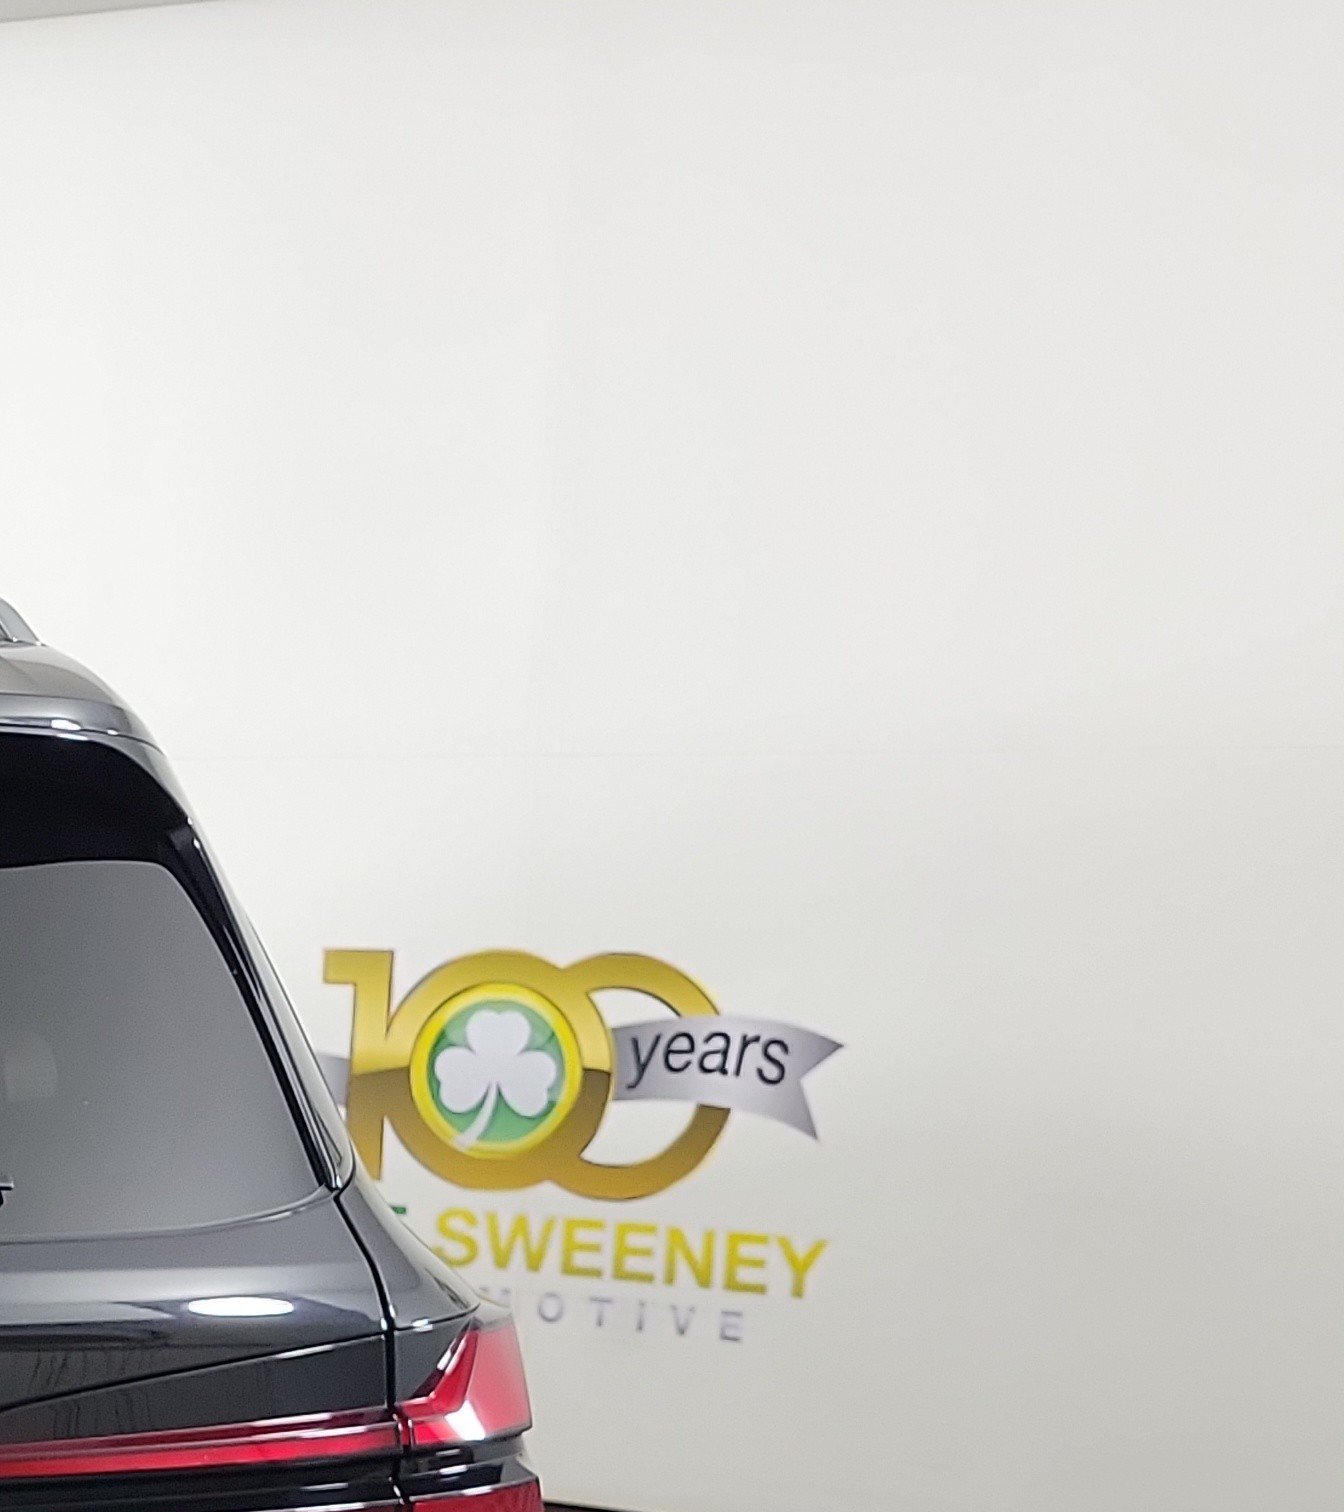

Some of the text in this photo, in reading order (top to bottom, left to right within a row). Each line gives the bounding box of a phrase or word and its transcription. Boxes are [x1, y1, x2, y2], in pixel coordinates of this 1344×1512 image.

[626, 1032, 791, 1090] years
[434, 1206, 828, 1298] SWEENEY
[478, 1286, 745, 1342] OTIVE
